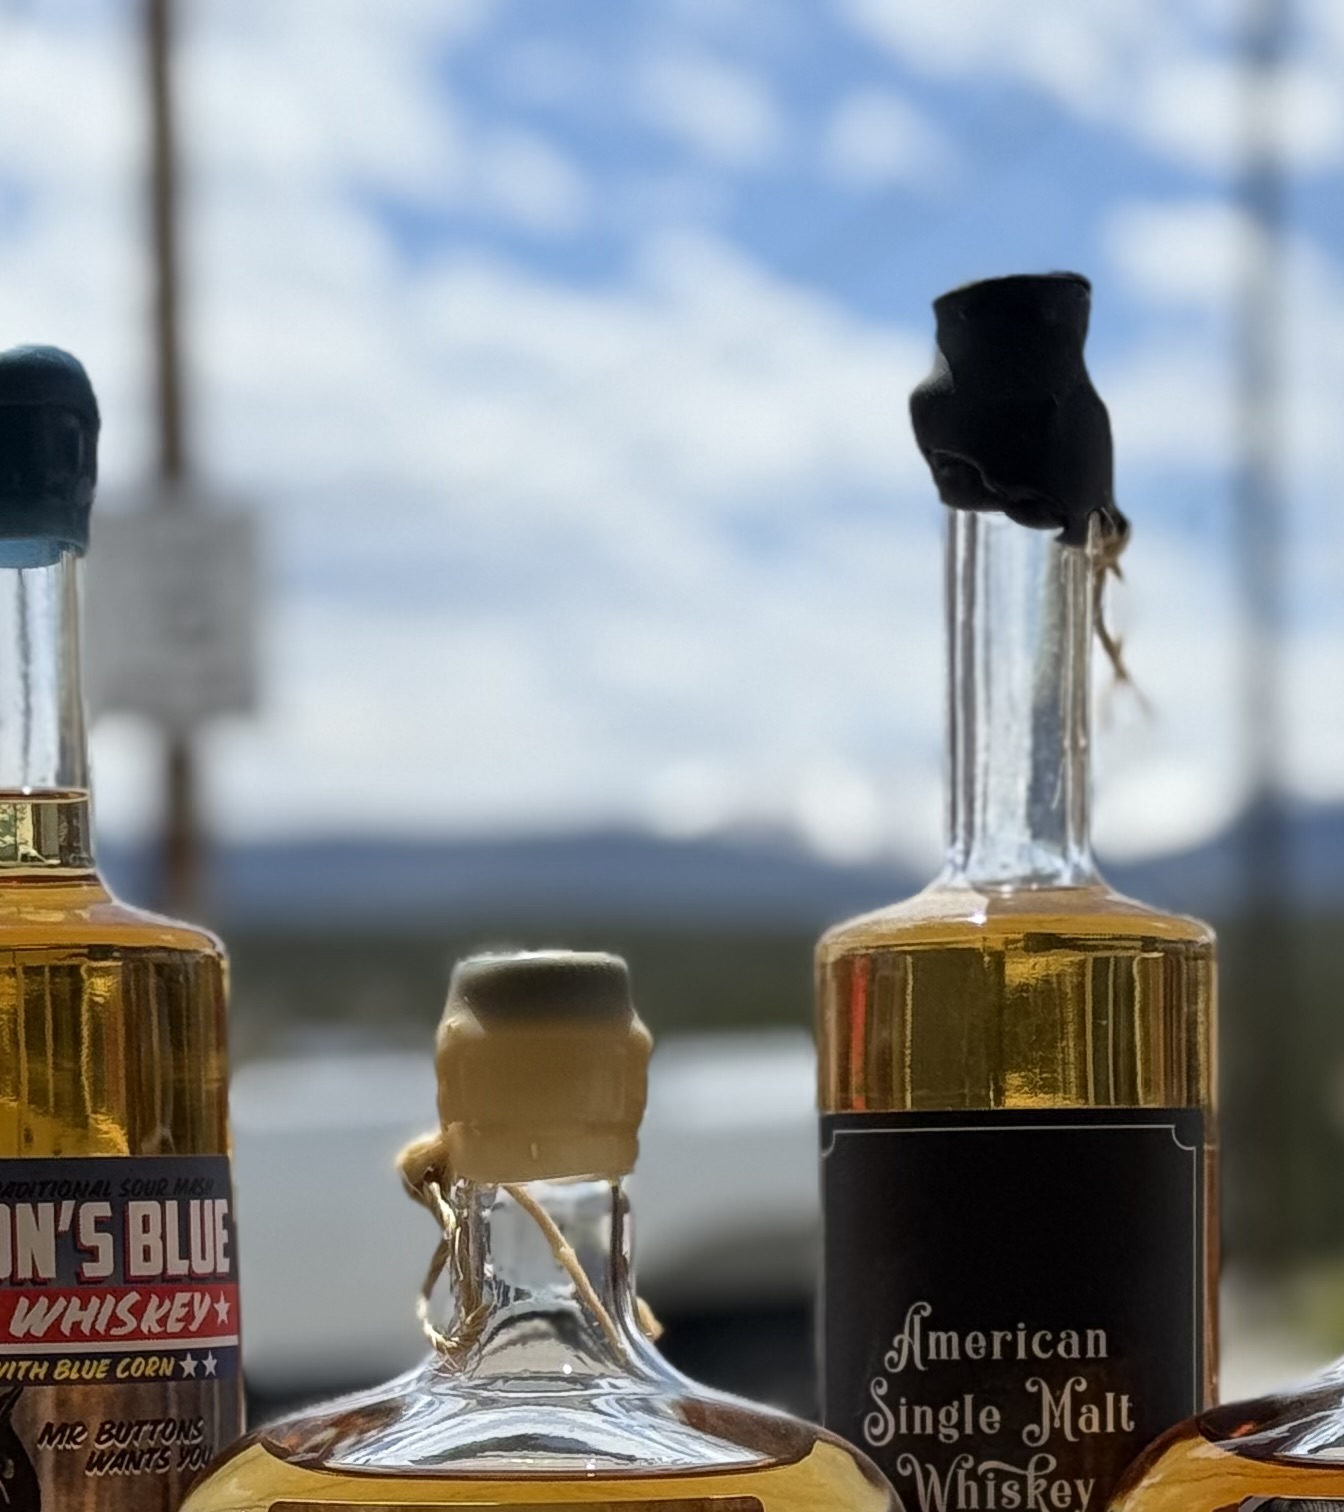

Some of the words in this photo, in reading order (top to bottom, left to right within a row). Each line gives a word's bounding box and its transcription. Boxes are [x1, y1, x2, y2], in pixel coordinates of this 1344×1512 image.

[119, 1179, 166, 1197] SOUR
[172, 1179, 214, 1196] MASH
[124, 1198, 231, 1282] BLUE
[8, 1291, 212, 1338] WHISKEY
[884, 1301, 1110, 1373] American
[54, 1357, 112, 1379] BLUE
[116, 1354, 176, 1378] CORN
[864, 1377, 1002, 1447] Single
[1022, 1376, 1136, 1447] Malt
[37, 1420, 88, 1449] MR
[95, 1417, 204, 1447] BUTTONS
[84, 1445, 172, 1477] WANTS
